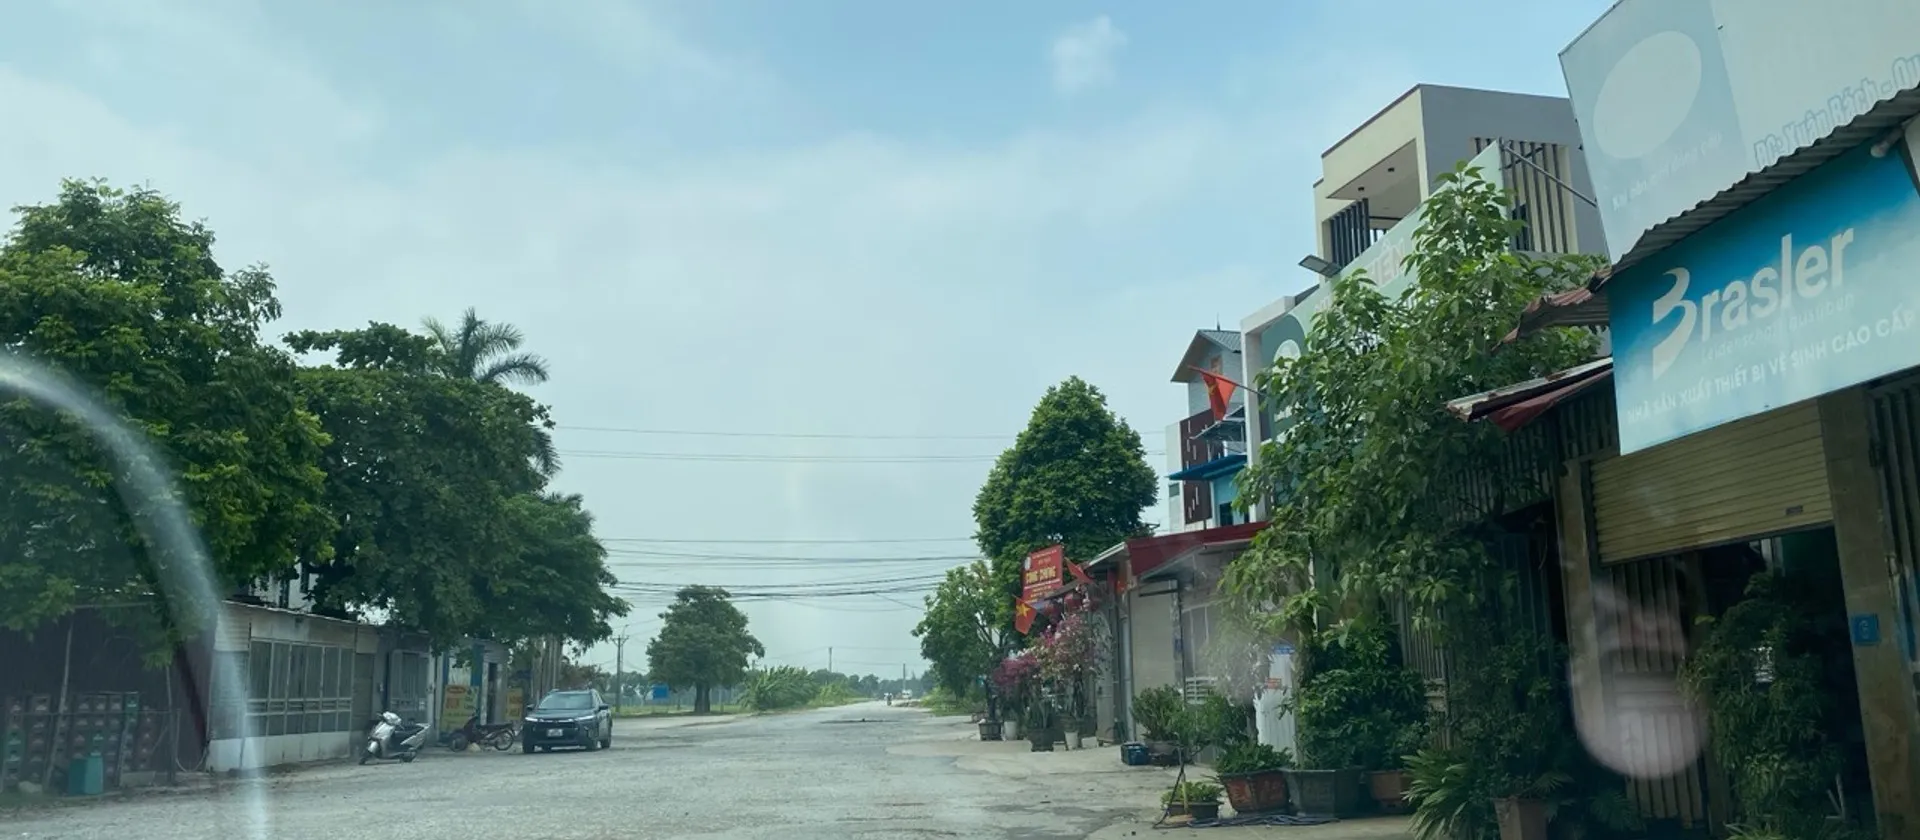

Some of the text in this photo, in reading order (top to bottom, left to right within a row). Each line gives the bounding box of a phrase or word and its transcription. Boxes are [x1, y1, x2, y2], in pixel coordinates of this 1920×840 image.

[1653, 228, 1854, 382] Brasler
[1714, 364, 1747, 396] THIẾT
[1751, 362, 1766, 386] BỊ
[1790, 339, 1827, 368] SINH
[1832, 325, 1871, 353] CAO
